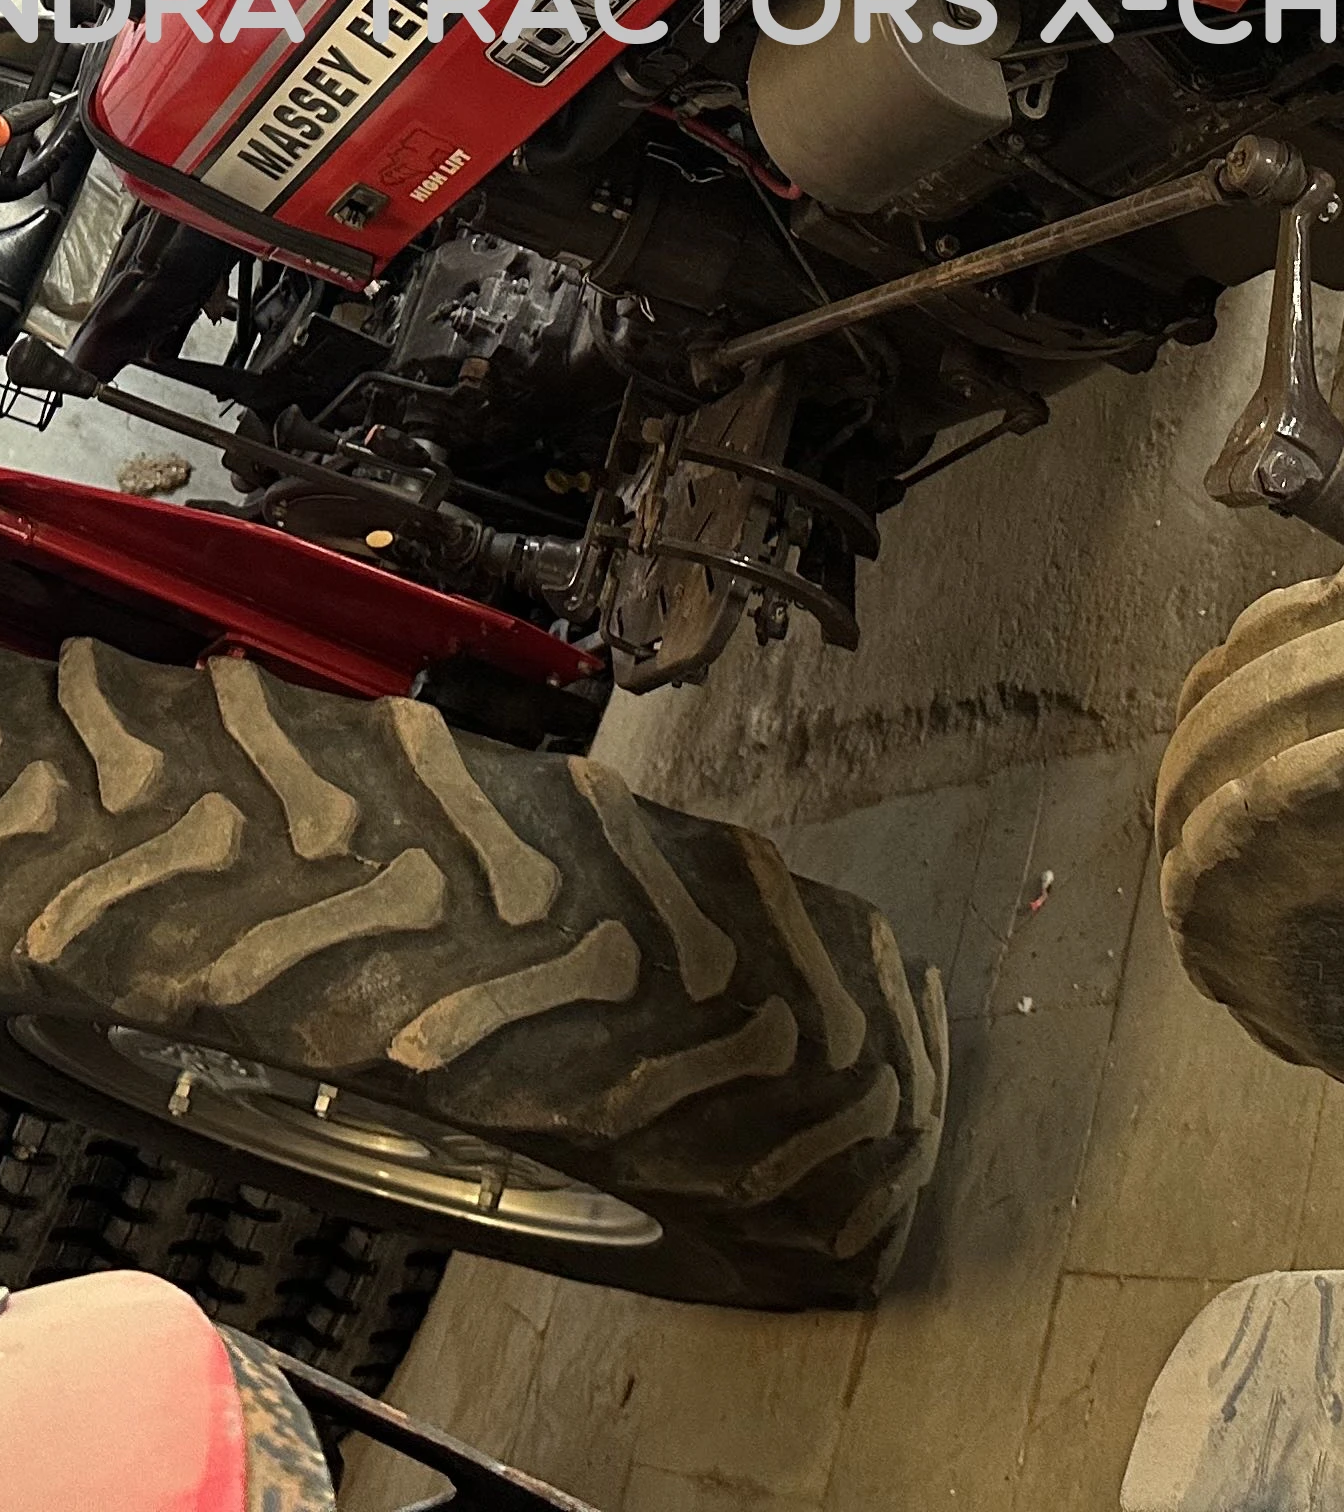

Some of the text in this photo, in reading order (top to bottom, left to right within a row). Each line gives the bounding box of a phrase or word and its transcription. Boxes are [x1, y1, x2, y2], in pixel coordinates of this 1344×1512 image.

[237, 48, 374, 181] MASSEY
[409, 148, 472, 203] HIGH LIFT
